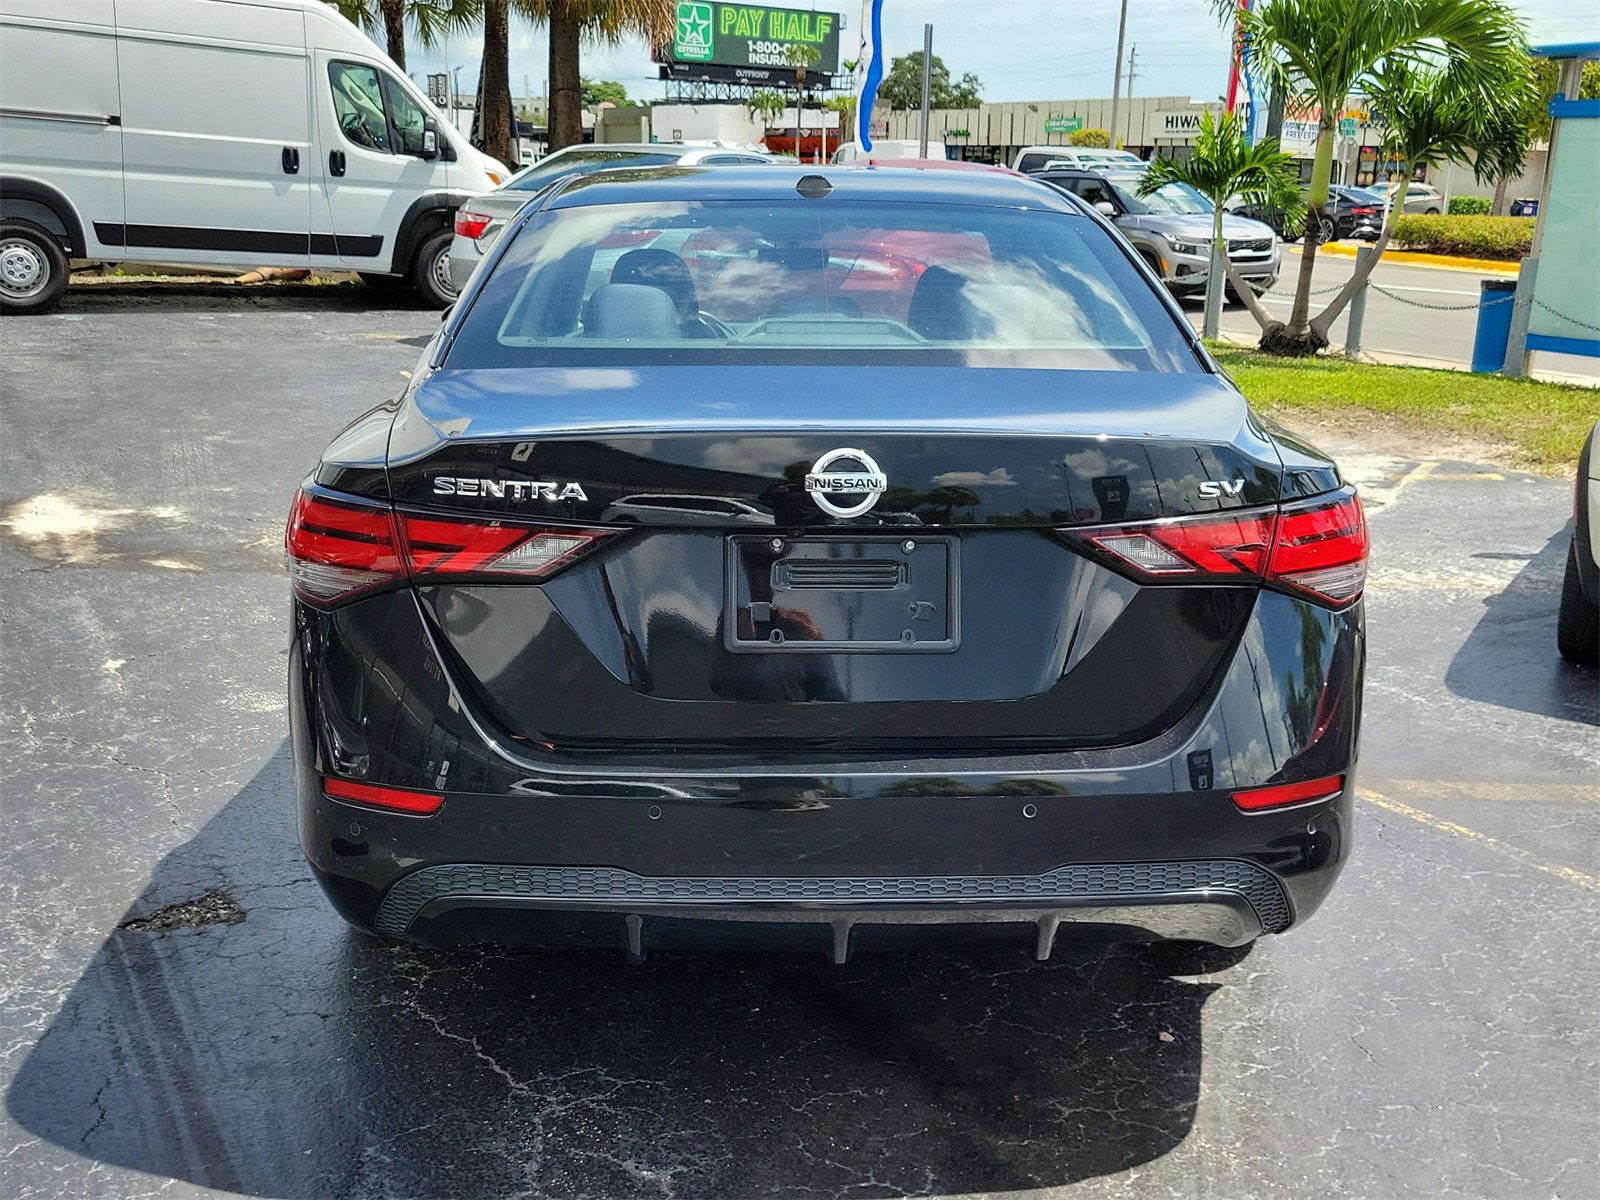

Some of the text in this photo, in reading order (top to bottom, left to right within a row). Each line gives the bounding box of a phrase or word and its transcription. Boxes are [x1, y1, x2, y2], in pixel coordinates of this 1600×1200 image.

[720, 6, 833, 43] PAY HALF
[677, 45, 710, 55] ESTRELLA
[1165, 115, 1201, 129] HIWA
[432, 476, 589, 501] SENTRA
[814, 478, 879, 492] NISSAN
[1198, 479, 1246, 500] SV
